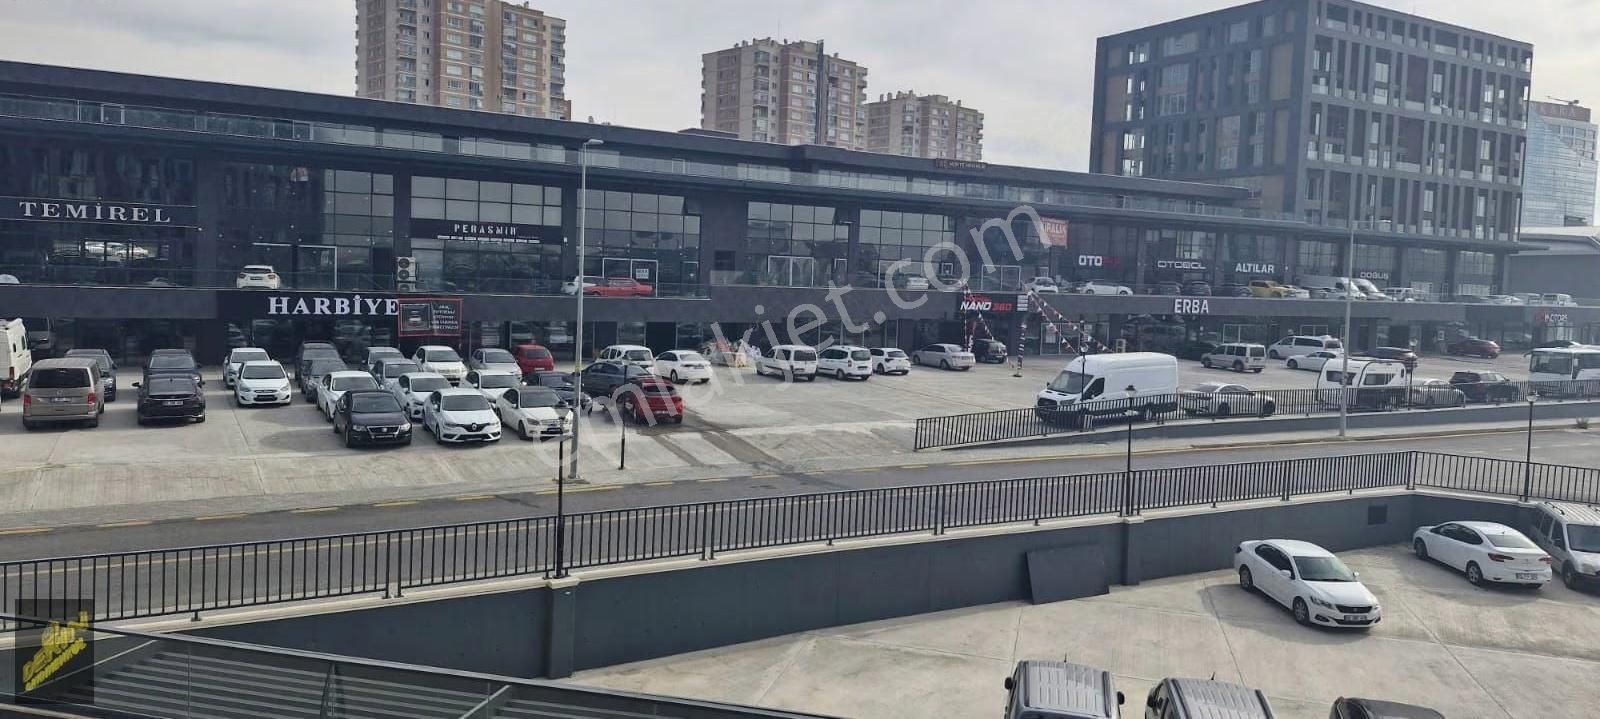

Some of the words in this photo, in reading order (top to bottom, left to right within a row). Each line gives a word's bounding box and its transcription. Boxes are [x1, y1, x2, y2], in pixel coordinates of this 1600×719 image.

[19, 201, 171, 223] TEMİREL
[1235, 262, 1276, 274] ALTILAR
[267, 294, 399, 316] HARBİYE
[960, 301, 992, 311] NANO
[1174, 298, 1209, 314] ERBA
